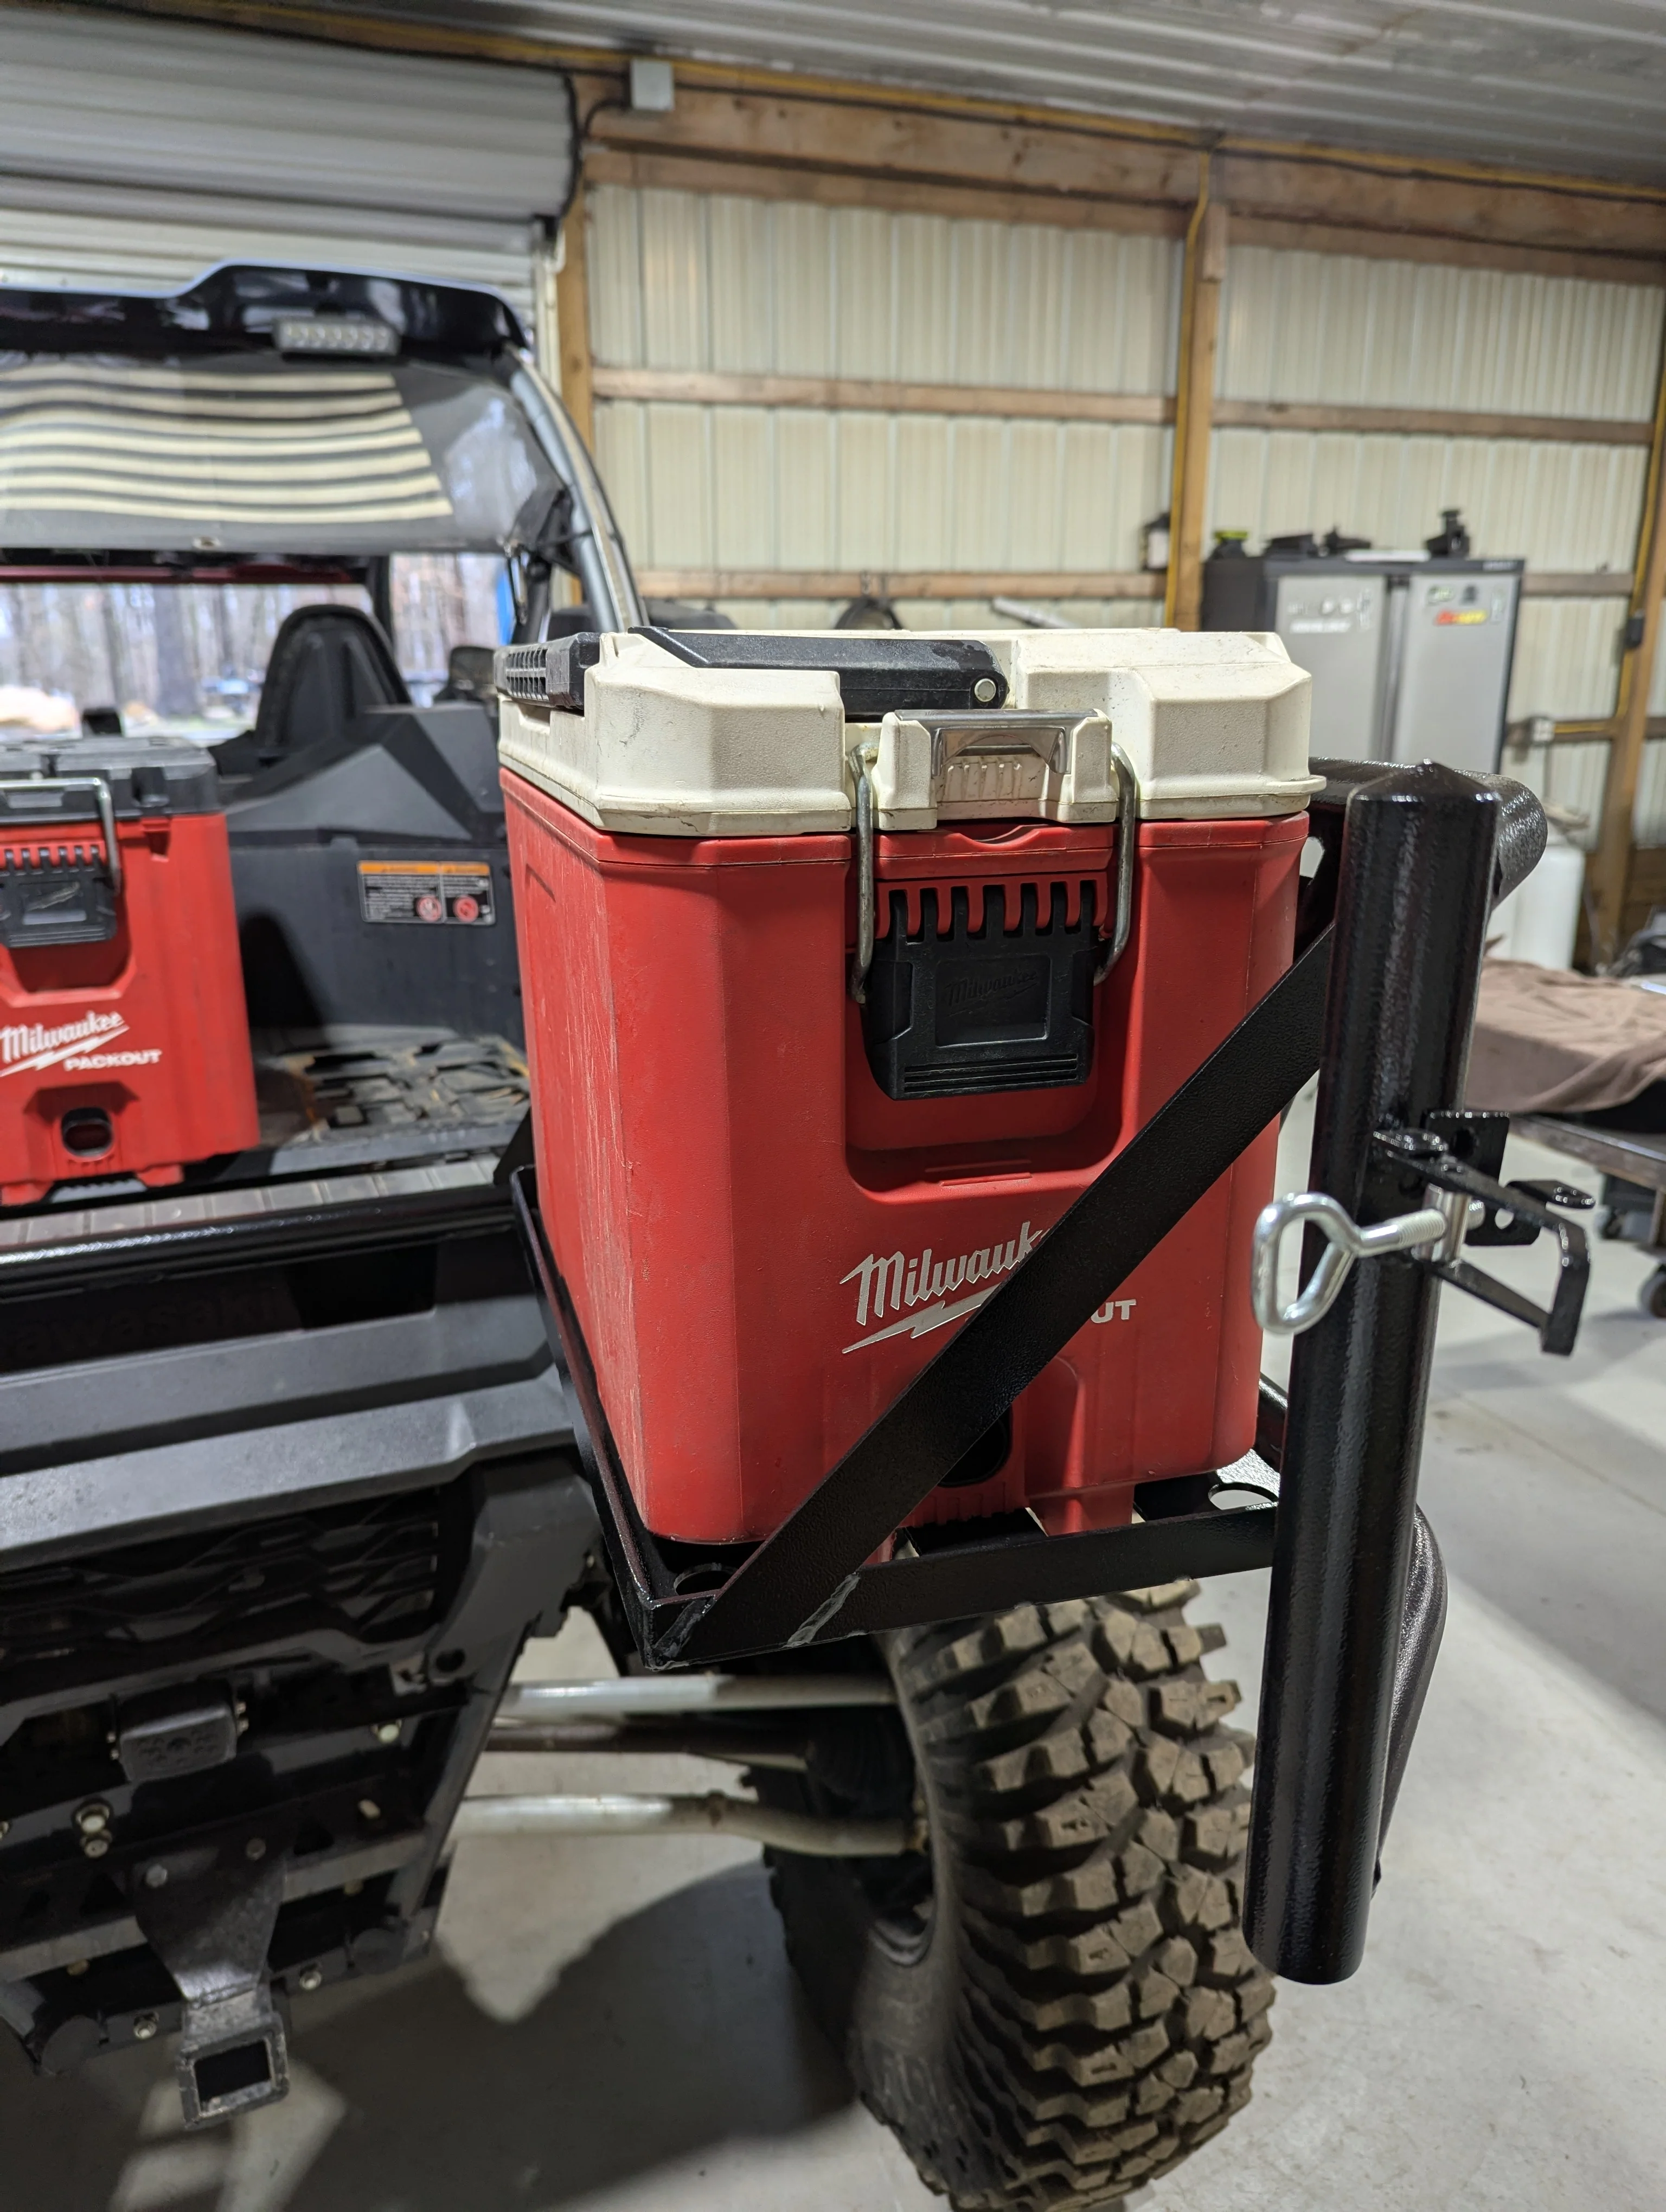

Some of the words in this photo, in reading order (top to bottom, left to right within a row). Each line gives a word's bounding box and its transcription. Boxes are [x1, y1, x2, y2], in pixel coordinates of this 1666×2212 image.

[944, 968, 1037, 1006] Milwaukee
[0, 1010, 125, 1063] Milwaukee
[63, 1049, 162, 1071] PACKOUT
[840, 1220, 1051, 1326] Milwauk
[0, 1283, 278, 1359] awasaki
